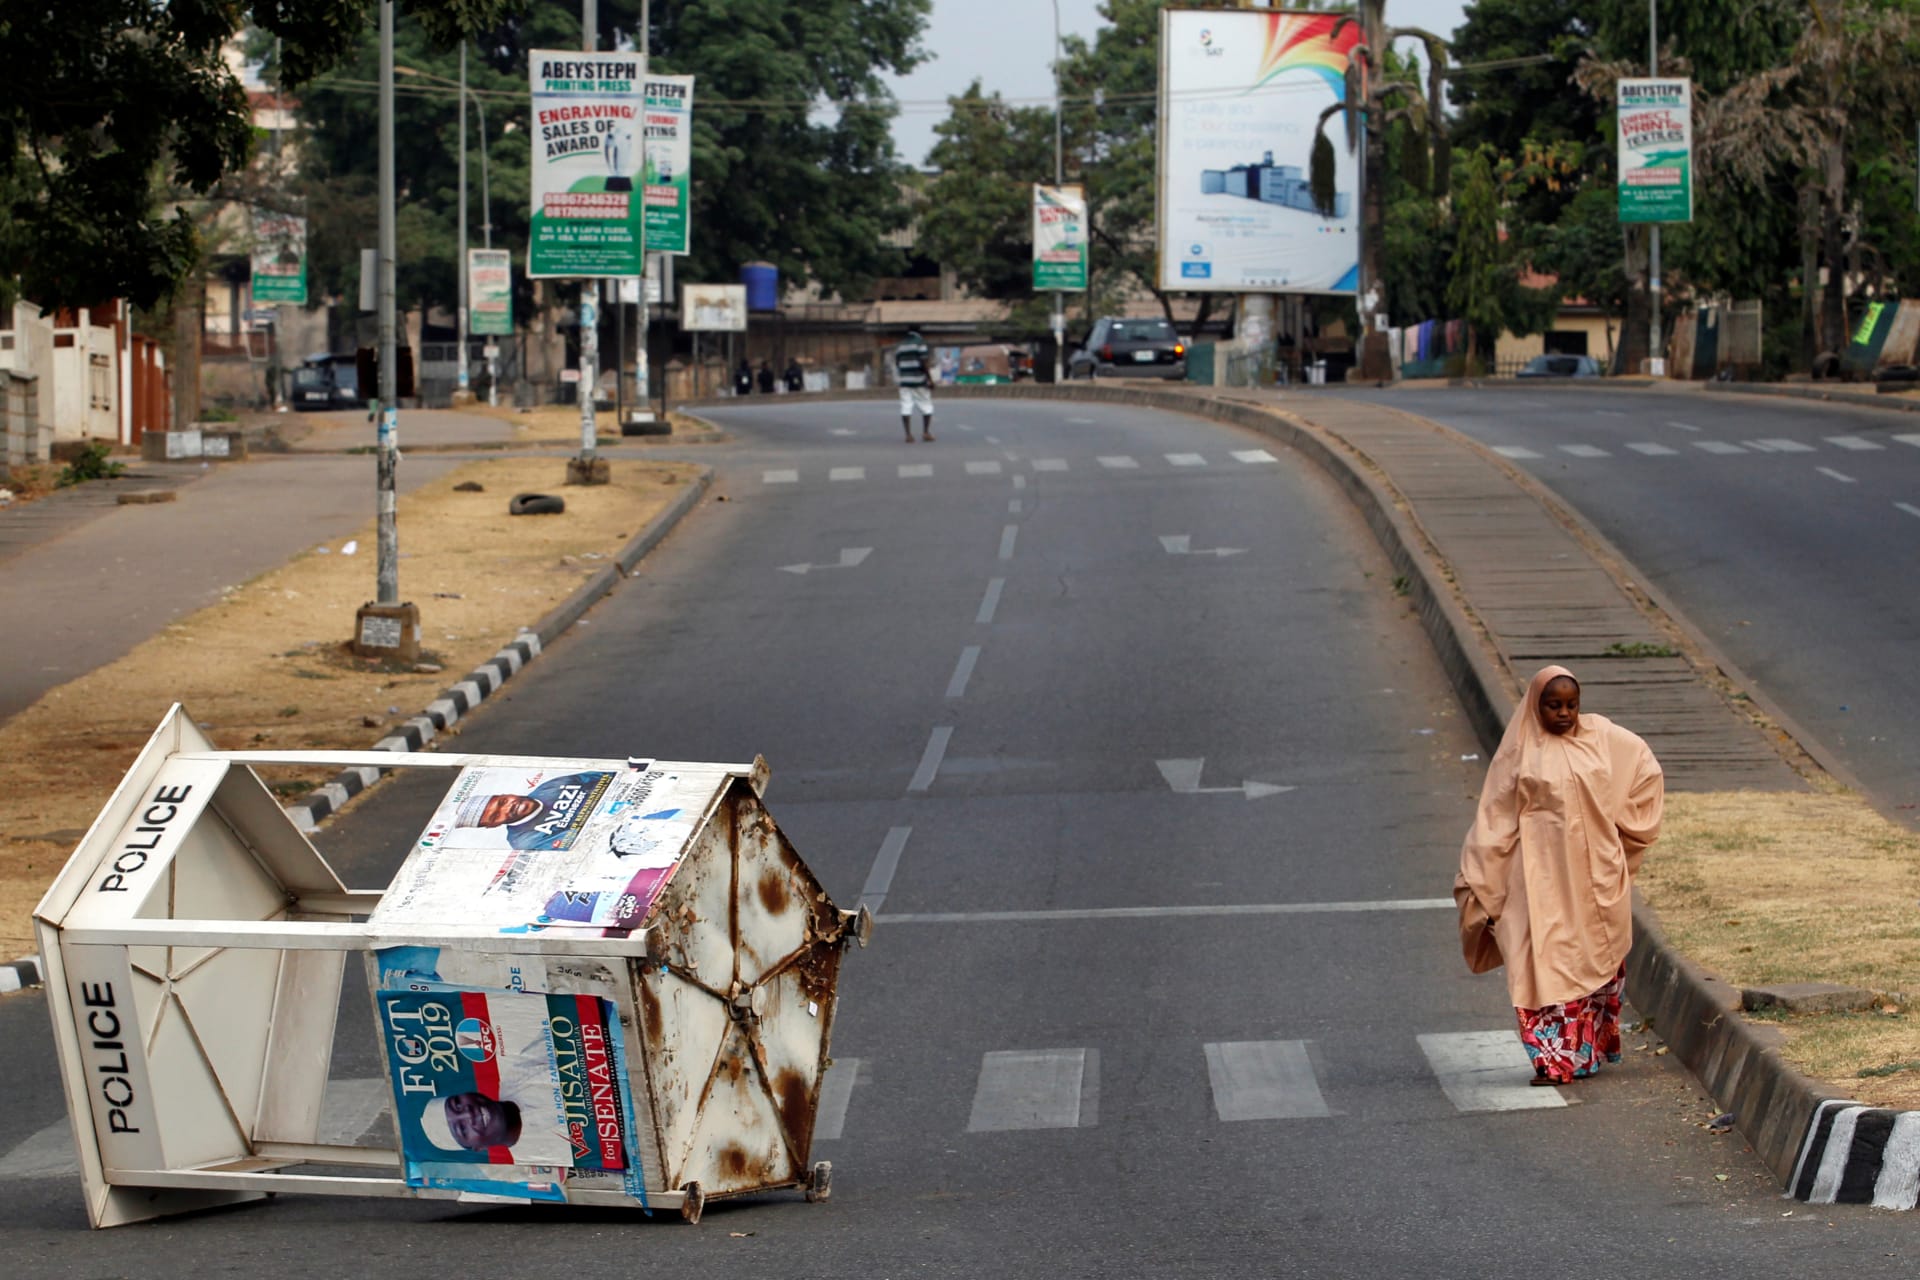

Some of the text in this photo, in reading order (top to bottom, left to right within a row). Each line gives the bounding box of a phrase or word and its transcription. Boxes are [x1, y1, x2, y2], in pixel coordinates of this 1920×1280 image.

[541, 61, 636, 79] ABEYSTEPH
[545, 80, 631, 92] PRINTING PRESS
[1622, 84, 1682, 96] ABEYSTEPH
[538, 104, 637, 125] ENGRAVING/
[1620, 109, 1670, 124] DIRECT
[1622, 119, 1670, 136] PRINT
[541, 119, 615, 141] SALES OF
[1626, 130, 1684, 149] TEXTILES
[546, 135, 599, 157] AWARD
[534, 785, 581, 834] Avazi
[557, 791, 587, 829] Ebenezer
[99, 784, 193, 893] POLICE
[386, 1000, 437, 1097] FCT
[422, 1002, 460, 1073] 2019
[482, 1027, 493, 1053] APC
[81, 981, 140, 1135] POLICE
[543, 1028, 559, 1083] ZAPHANIAH
[550, 1016, 589, 1128] JISALO
[582, 1024, 620, 1138] SENATE
[557, 1122, 591, 1159] Vote
[604, 1142, 616, 1160] for
